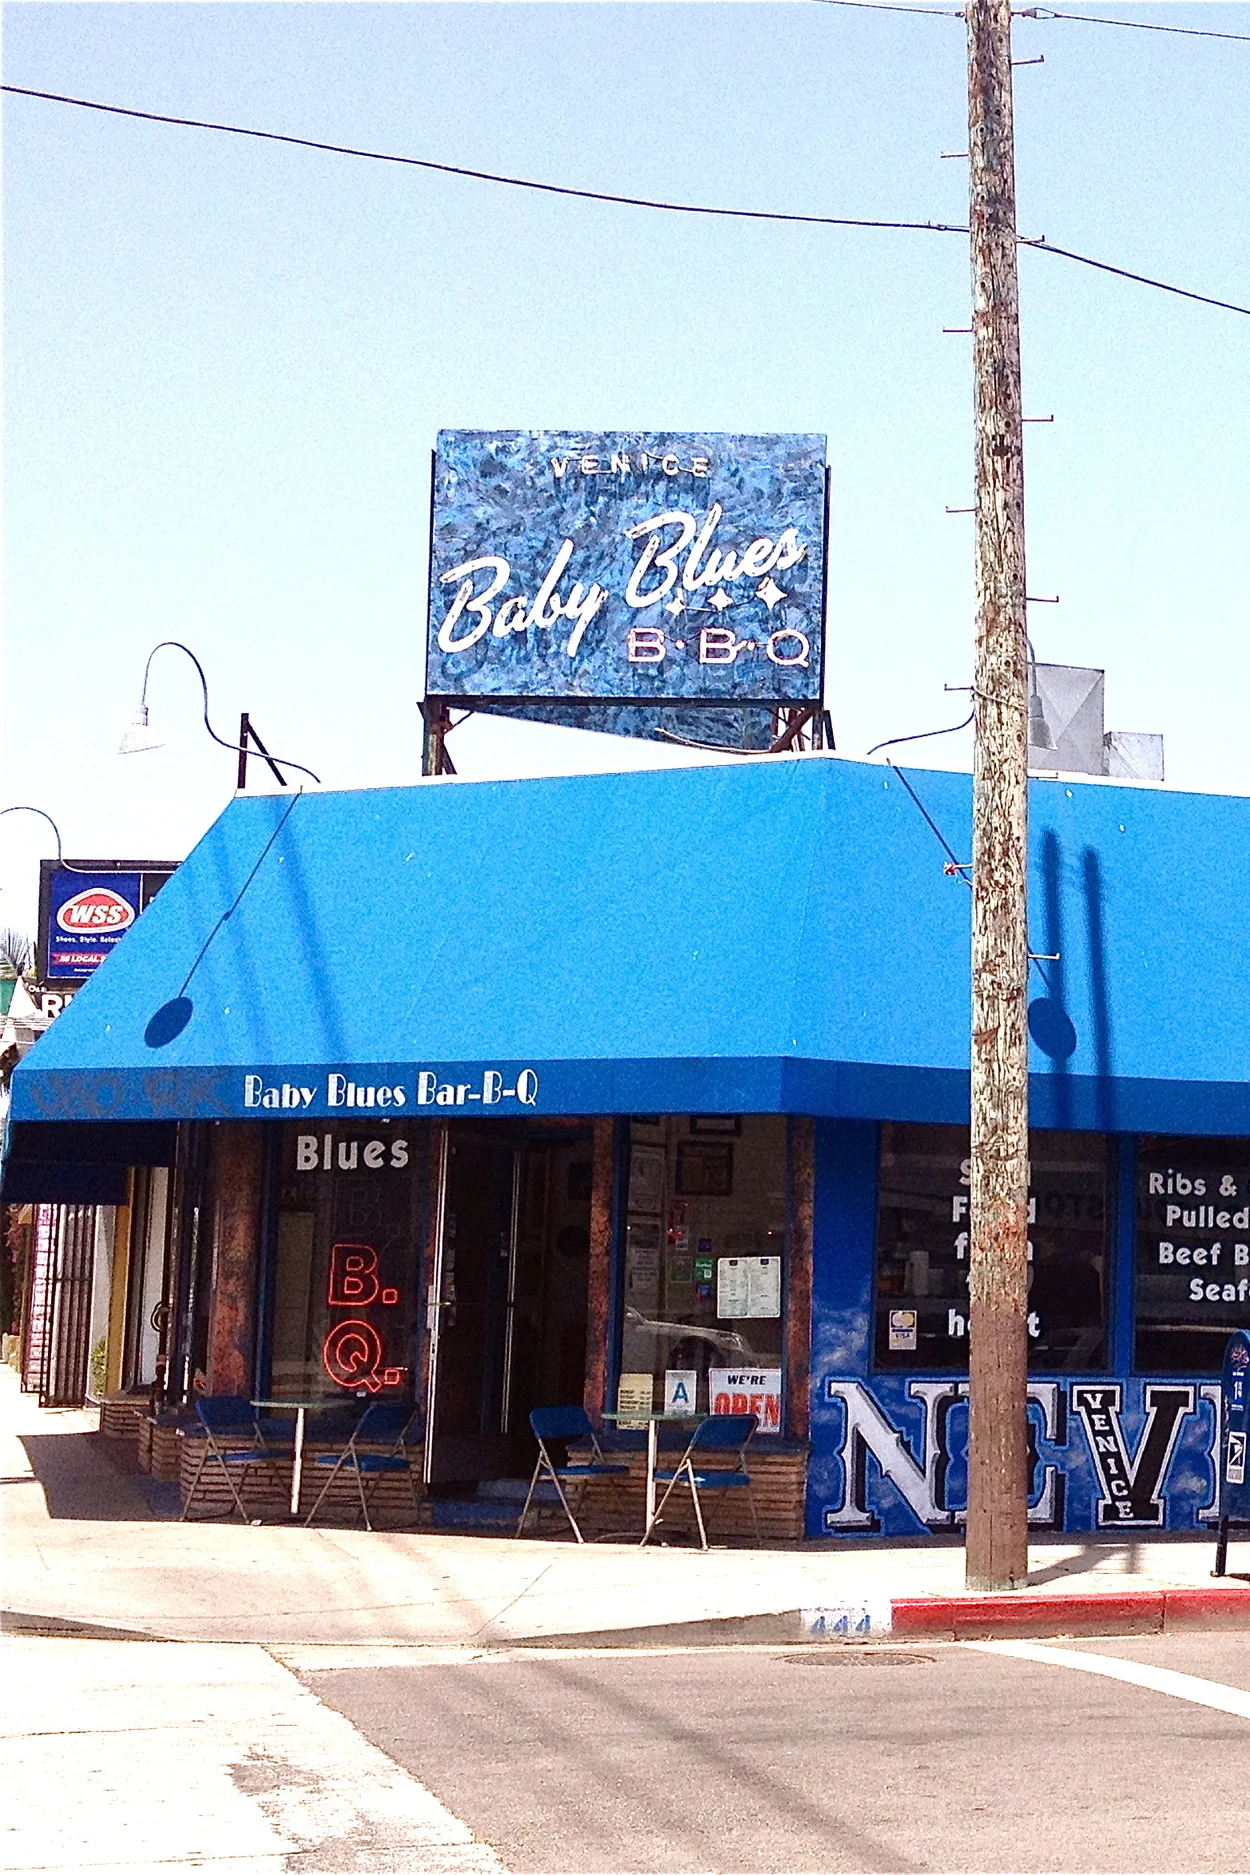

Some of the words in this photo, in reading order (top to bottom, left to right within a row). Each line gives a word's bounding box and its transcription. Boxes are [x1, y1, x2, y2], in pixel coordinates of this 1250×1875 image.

[551, 453, 710, 478] VENICE
[437, 540, 608, 657] Baby
[625, 503, 809, 609] Blues
[69, 905, 124, 924] WSS
[244, 1075, 317, 1109] Baby
[327, 1073, 406, 1108] Blues
[417, 1068, 538, 1107] Bar-B-Q
[296, 1134, 409, 1171] Blues
[1149, 1168, 1206, 1196] Ribs
[1219, 1174, 1238, 1197] &
[1166, 1205, 1249, 1229] Pulled
[1158, 1242, 1222, 1265] Beef
[671, 1382, 690, 1404] A
[727, 1375, 767, 1386] WE'RE
[714, 1392, 780, 1428] OPEN
[1083, 1393, 1134, 1519] VENICE
